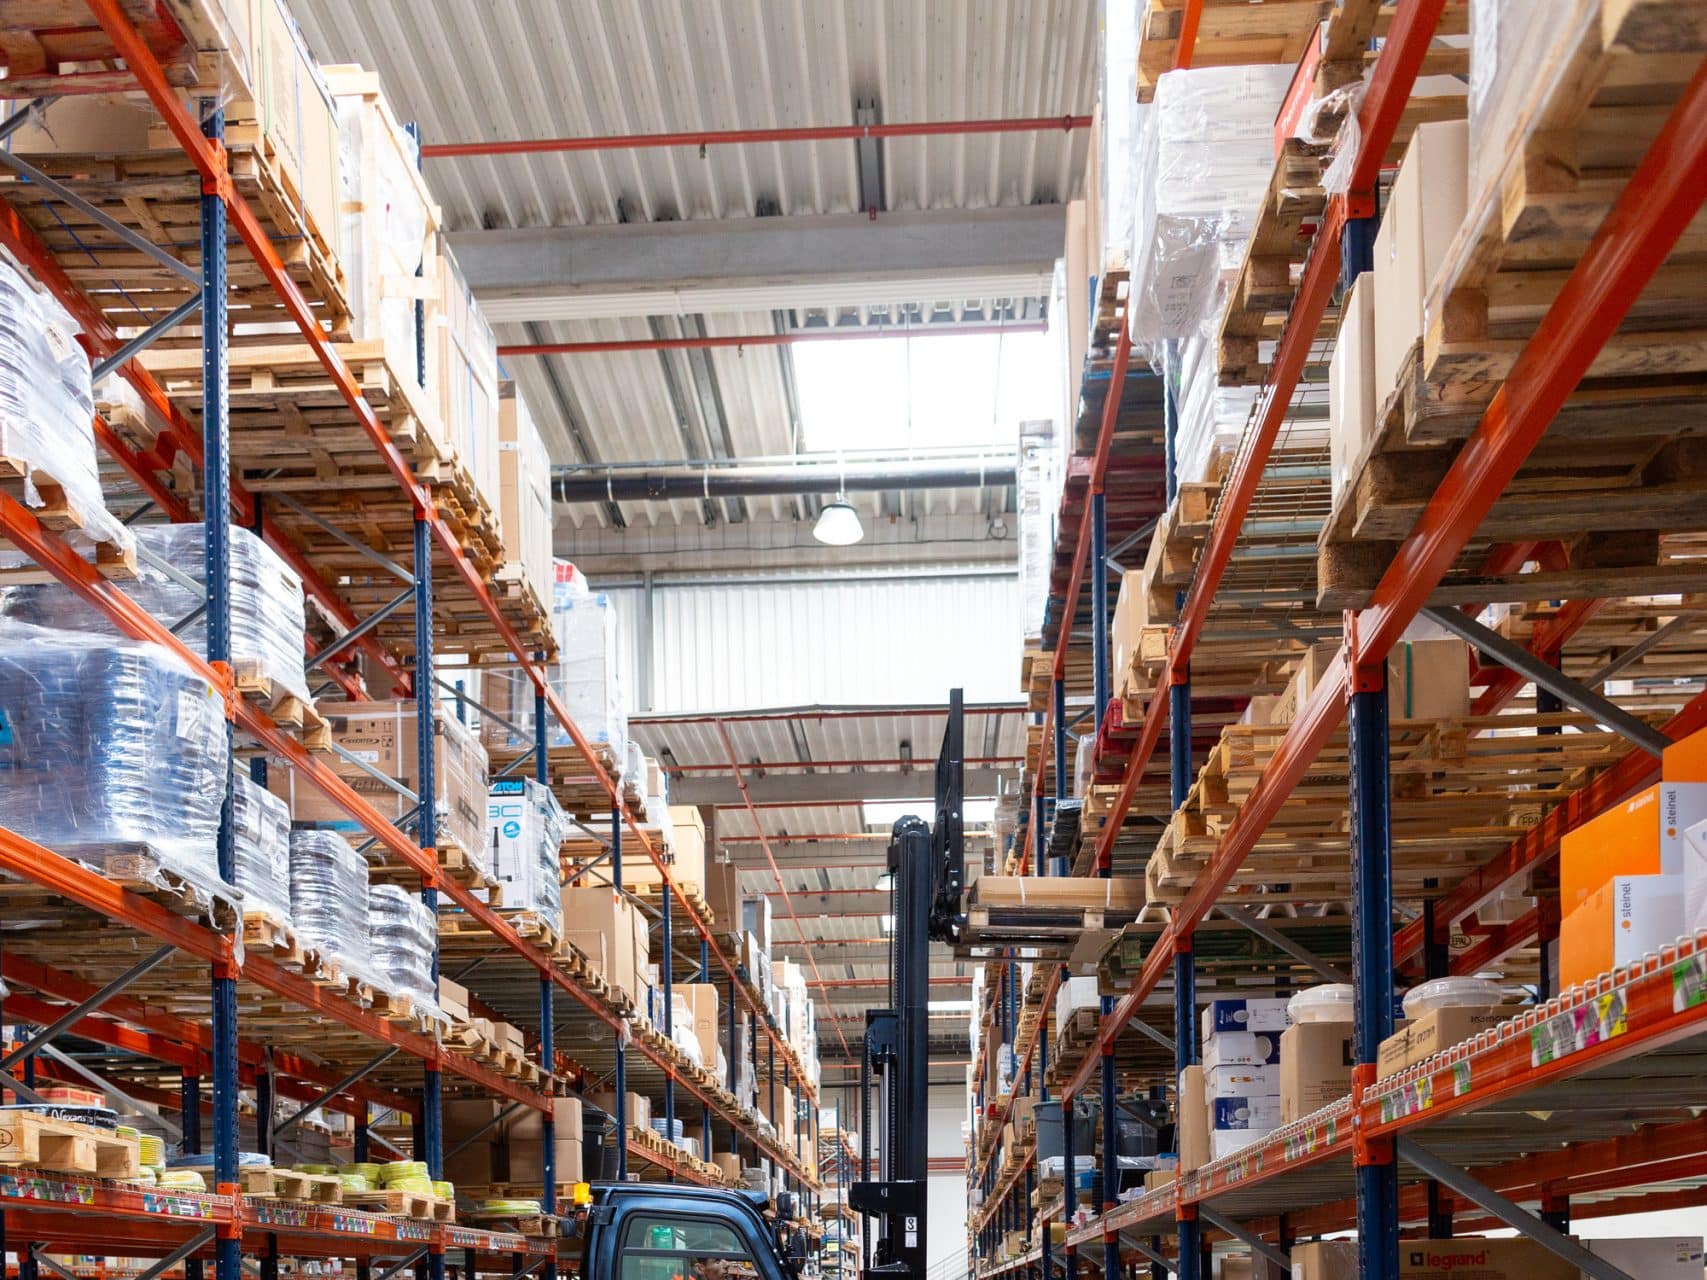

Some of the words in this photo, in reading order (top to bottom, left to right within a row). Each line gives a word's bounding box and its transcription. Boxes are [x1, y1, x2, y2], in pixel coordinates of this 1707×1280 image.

[1667, 790, 1676, 825] steinel
[1622, 882, 1631, 918] steinel
[1427, 1251, 1486, 1270] legrand
